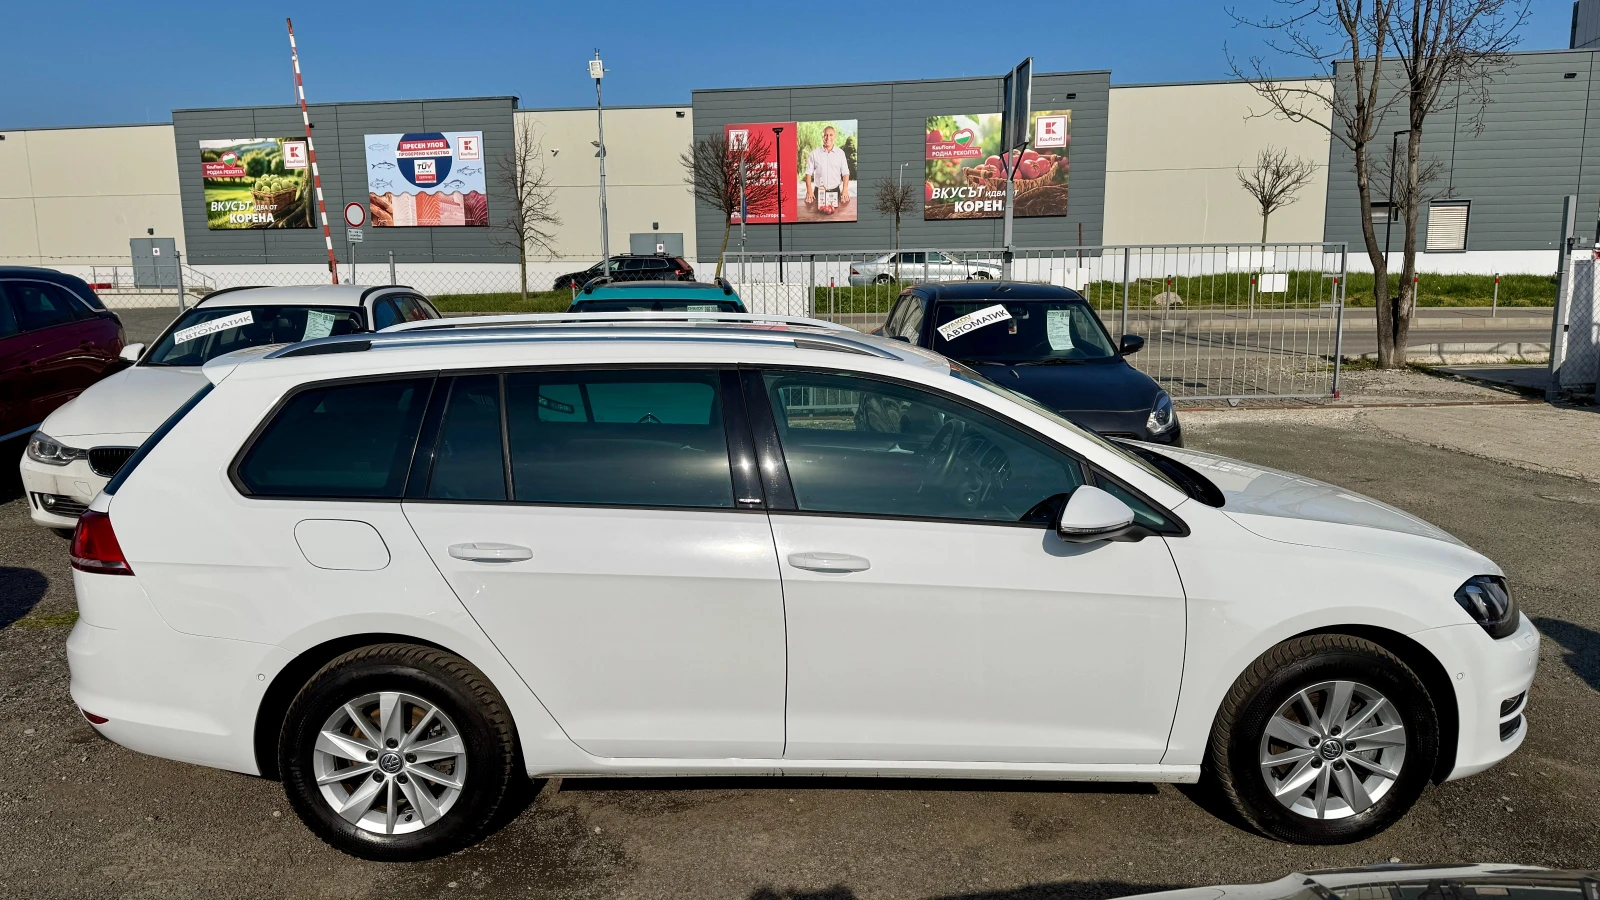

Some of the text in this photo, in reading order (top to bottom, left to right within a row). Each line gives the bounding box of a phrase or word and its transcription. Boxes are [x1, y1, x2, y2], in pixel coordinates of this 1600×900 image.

[402, 141, 445, 150] ПРЕСЕН УЛОВ
[417, 161, 433, 170] TÜV
[931, 186, 986, 199] ВКУСЪТ
[210, 200, 252, 212] ВКУСЪТ
[954, 199, 1005, 213] КОРЕН
[229, 213, 275, 224] КОРЕНА
[176, 315, 251, 344] АВТОМАТИК
[946, 309, 1009, 340] АВТОМАТИК
